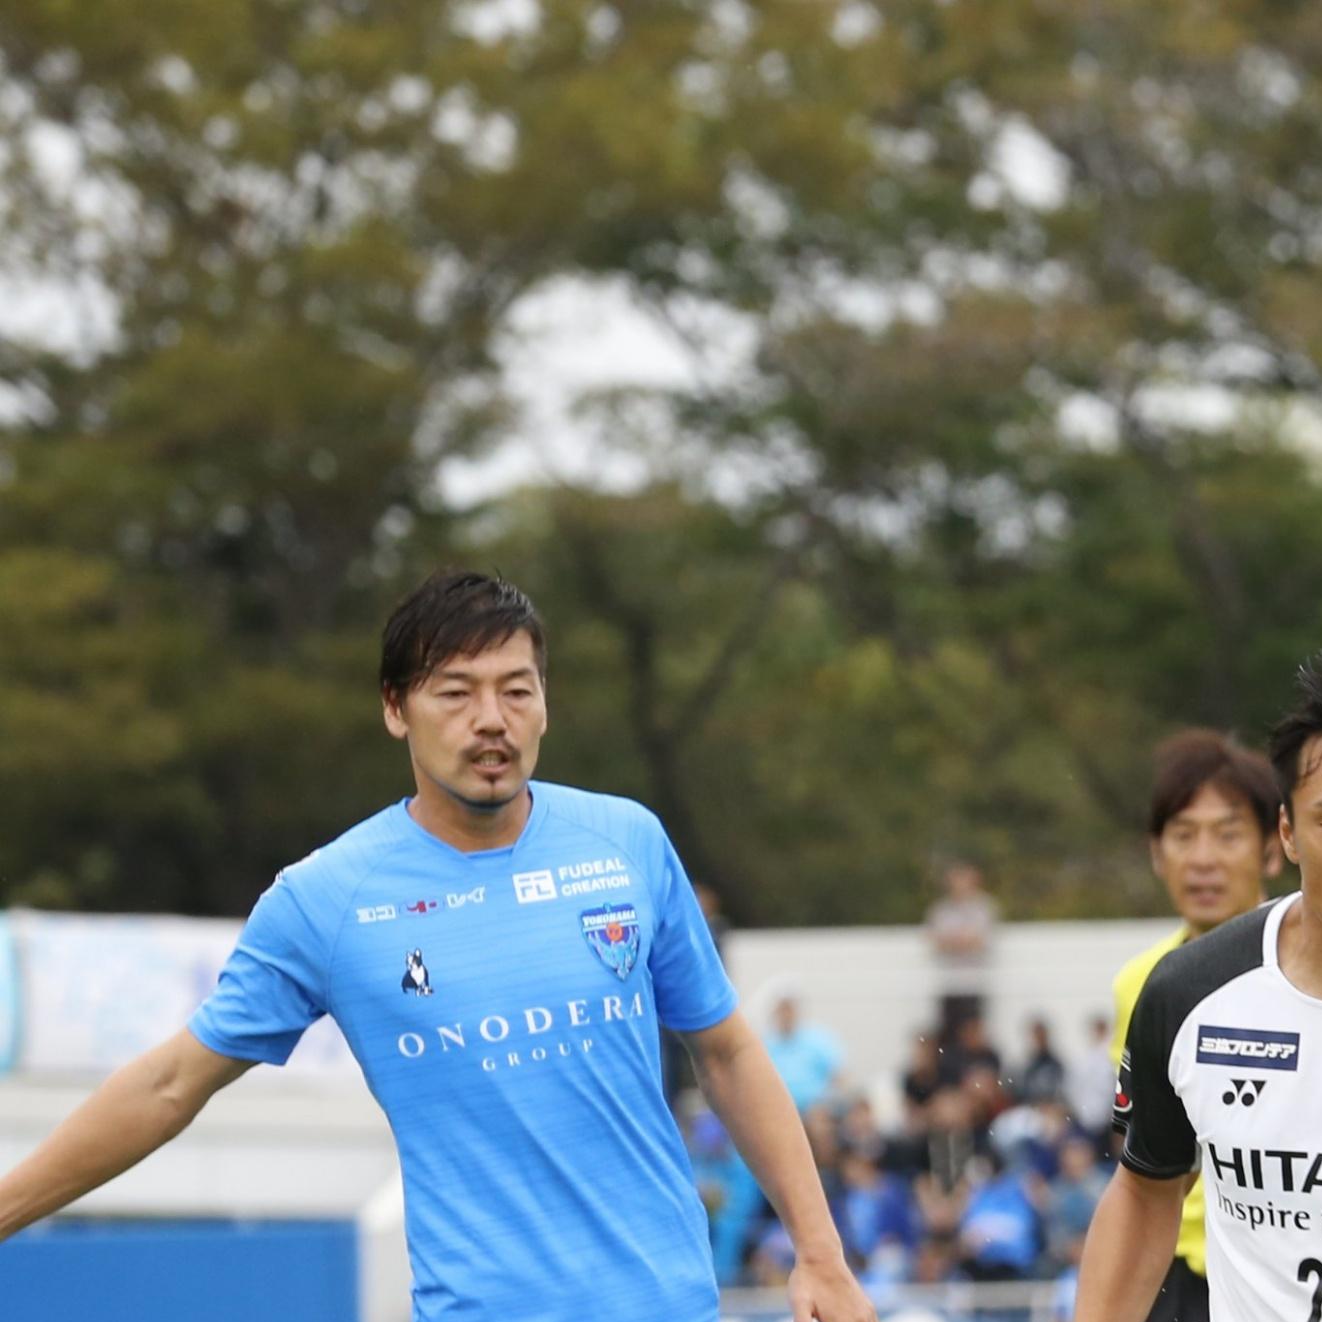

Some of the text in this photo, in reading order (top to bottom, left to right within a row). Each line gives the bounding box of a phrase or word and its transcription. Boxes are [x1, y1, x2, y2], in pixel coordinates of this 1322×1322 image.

[558, 857, 625, 880] FUDEAL
[561, 875, 630, 896] CREATION
[582, 909, 637, 928] YOKOHAMA
[398, 992, 644, 1058] ONODERA
[482, 1039, 593, 1072] GROUP
[1215, 1183, 1310, 1231] Inspire
